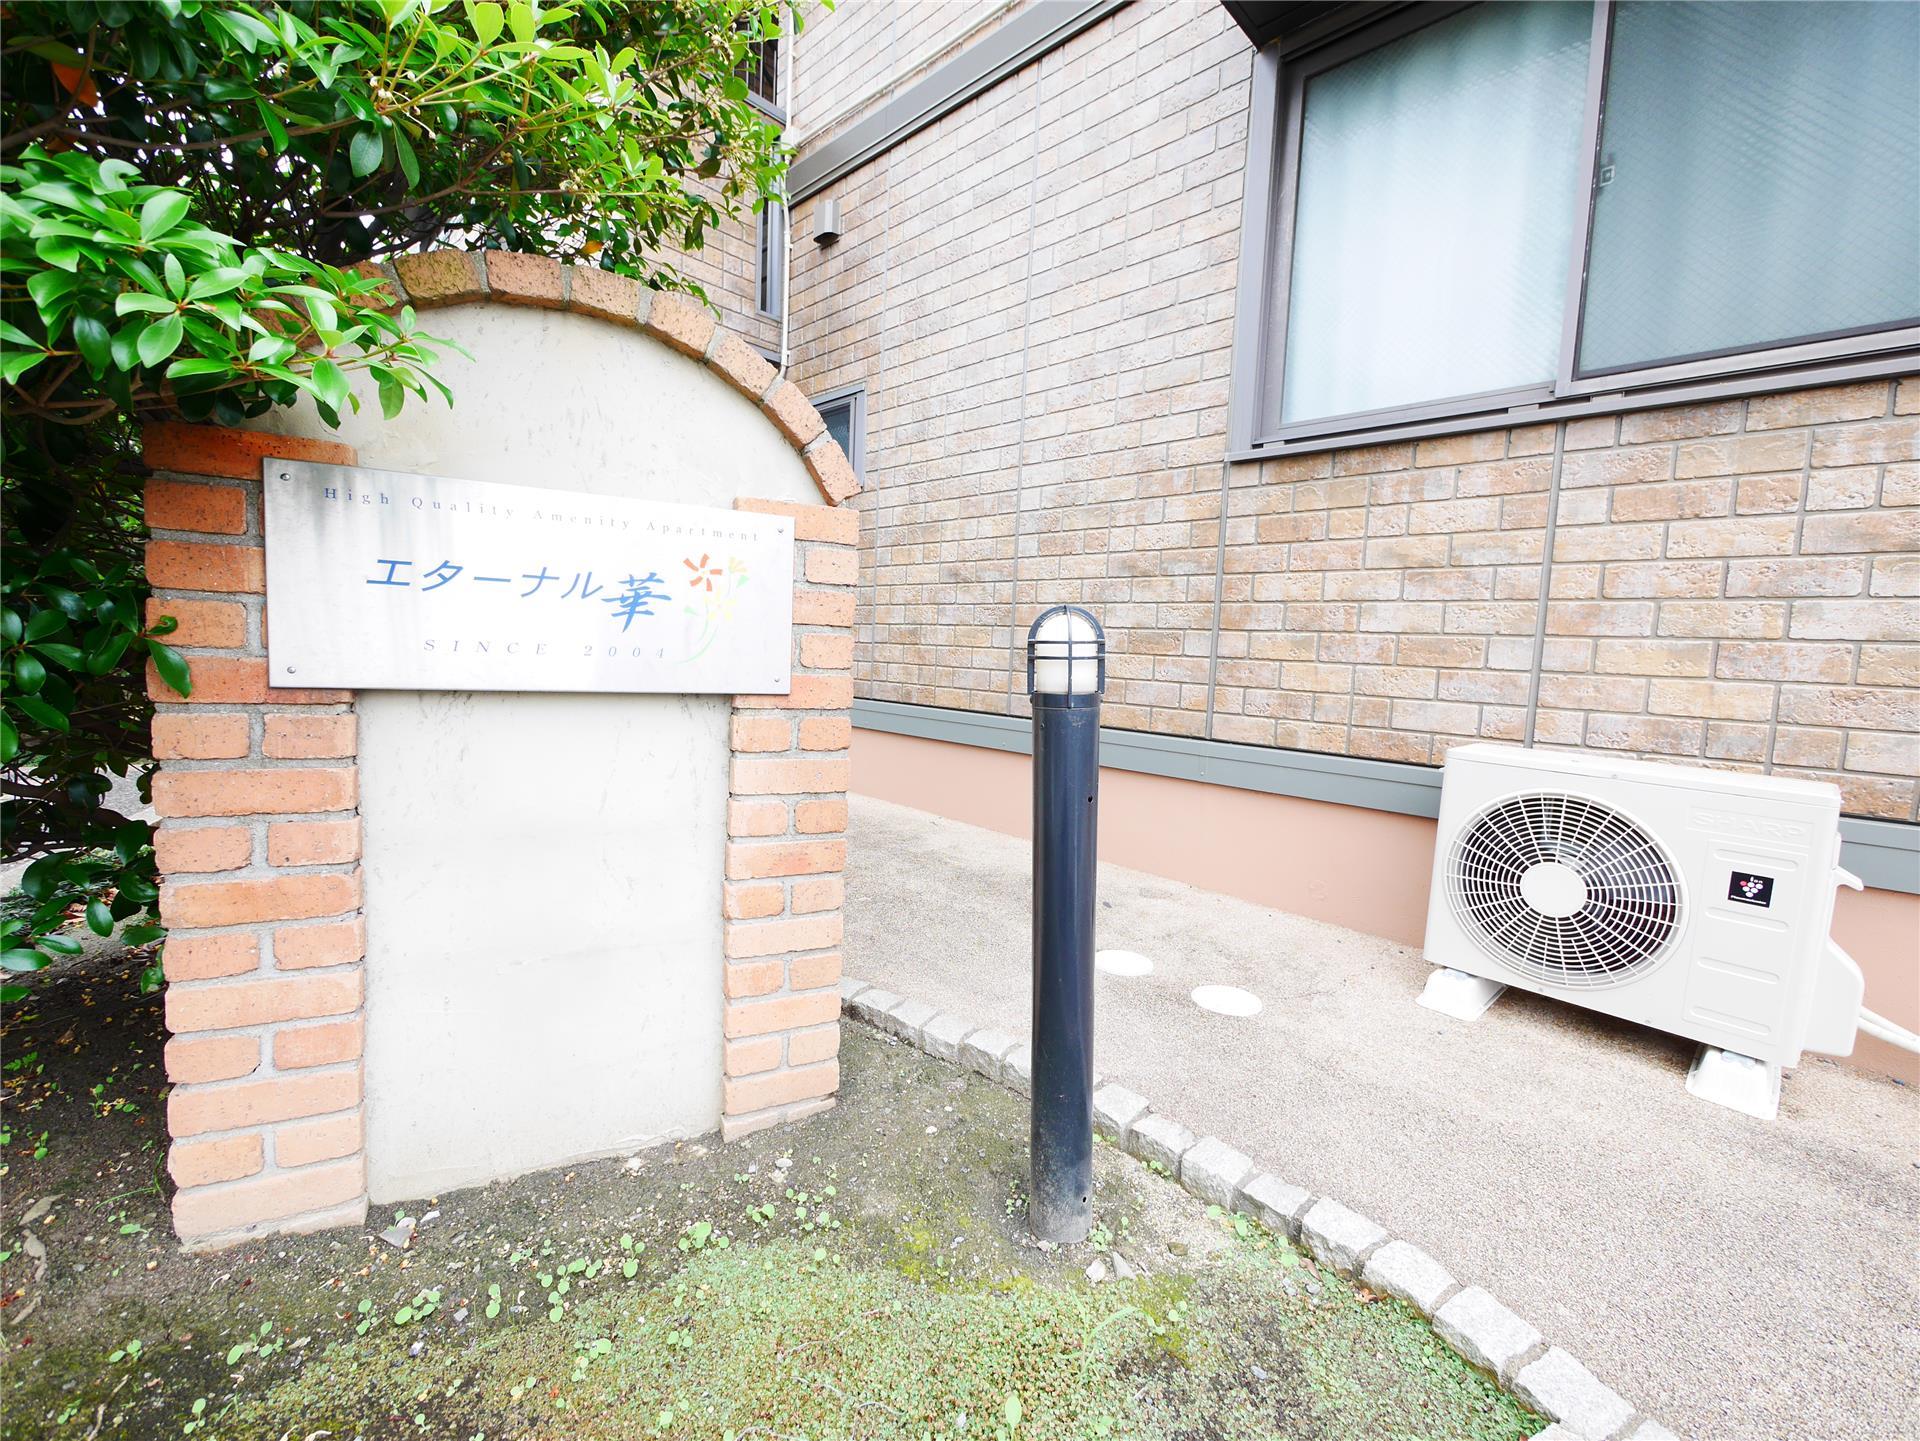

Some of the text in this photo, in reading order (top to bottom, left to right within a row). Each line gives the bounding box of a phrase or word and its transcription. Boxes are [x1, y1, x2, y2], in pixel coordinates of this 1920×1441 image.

[323, 487, 760, 541] High Quality Amenity Apartment
[366, 559, 671, 632] エターナル華
[423, 640, 665, 659] SINCE 2004
[1691, 811, 1807, 838] SHARP
